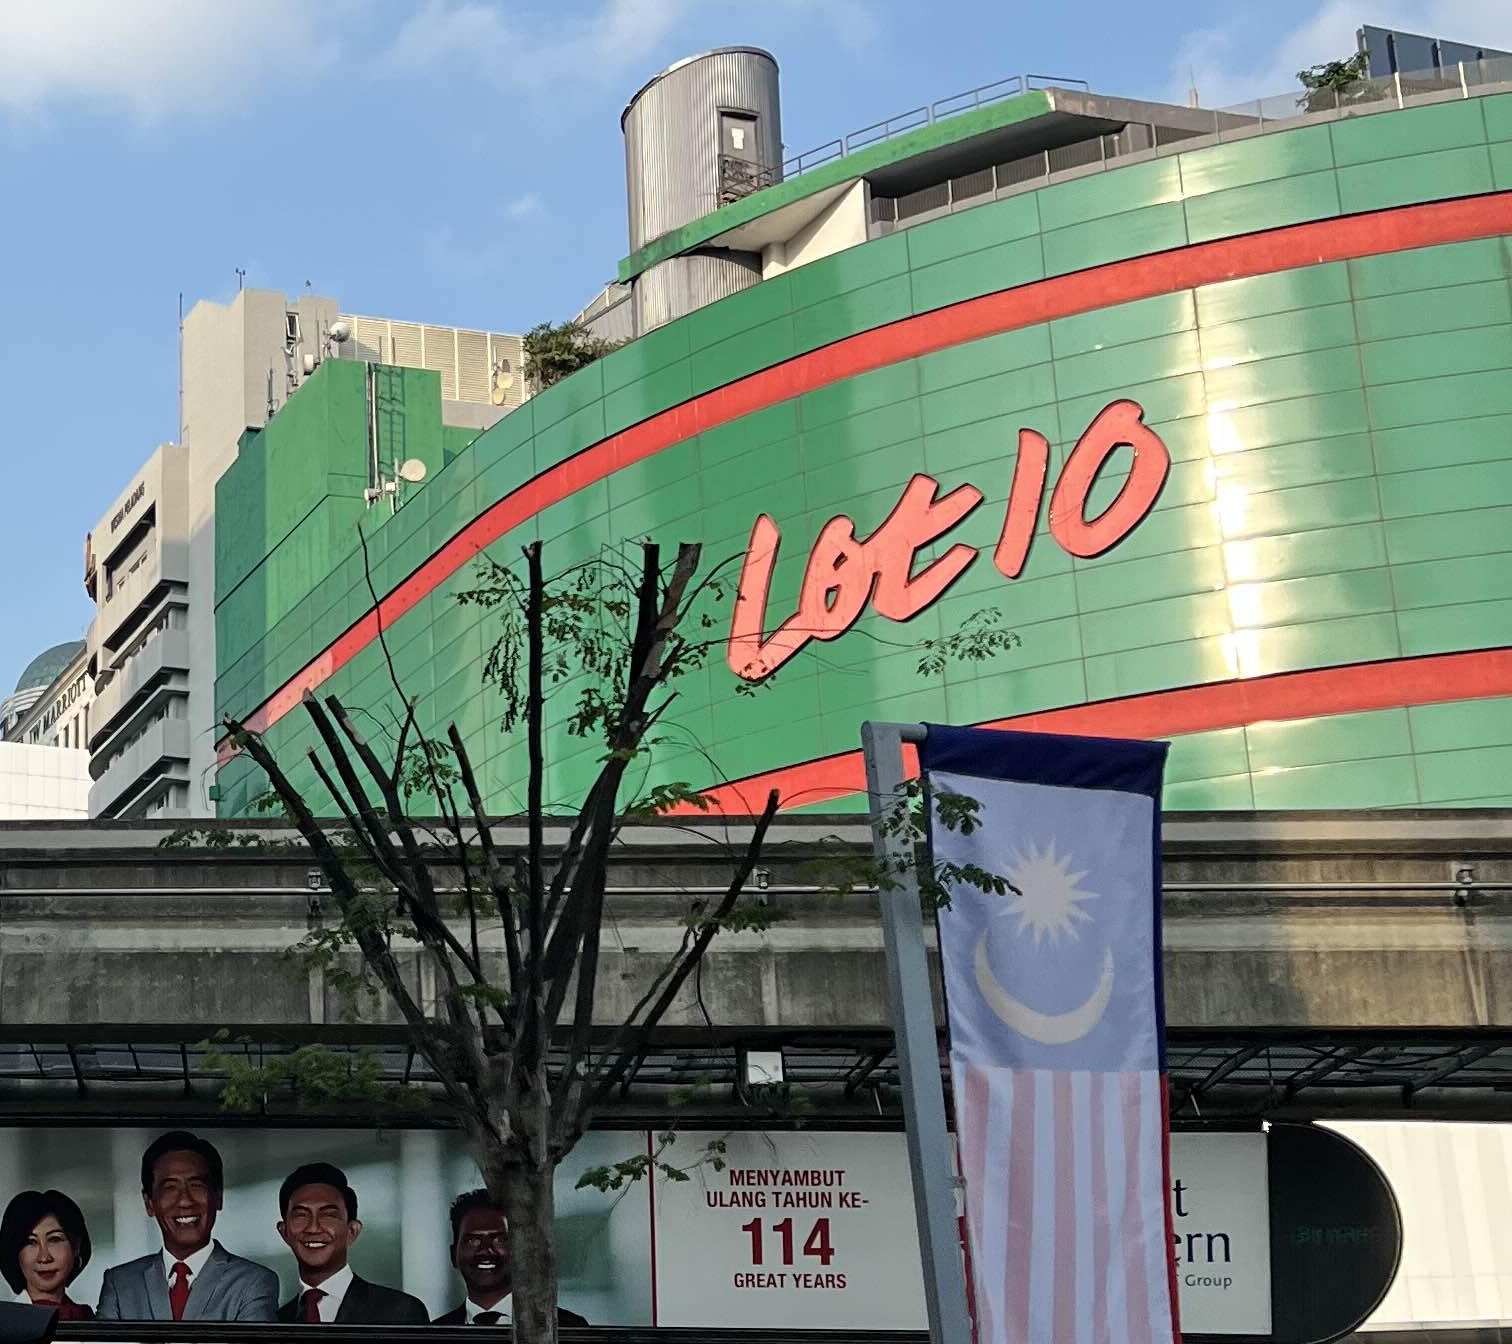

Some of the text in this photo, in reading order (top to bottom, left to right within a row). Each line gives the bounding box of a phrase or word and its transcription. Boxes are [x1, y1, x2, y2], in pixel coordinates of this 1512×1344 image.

[728, 398, 1171, 681] Lot 10
[43, 671, 89, 735] MARRIOTT
[729, 1169, 845, 1187] MENYAMBUT
[706, 1191, 869, 1208] ULANG TAHUN KE-
[742, 1217, 835, 1265] 114
[734, 1272, 847, 1289] GREAT YEARS
[1184, 1274, 1232, 1290] Group
